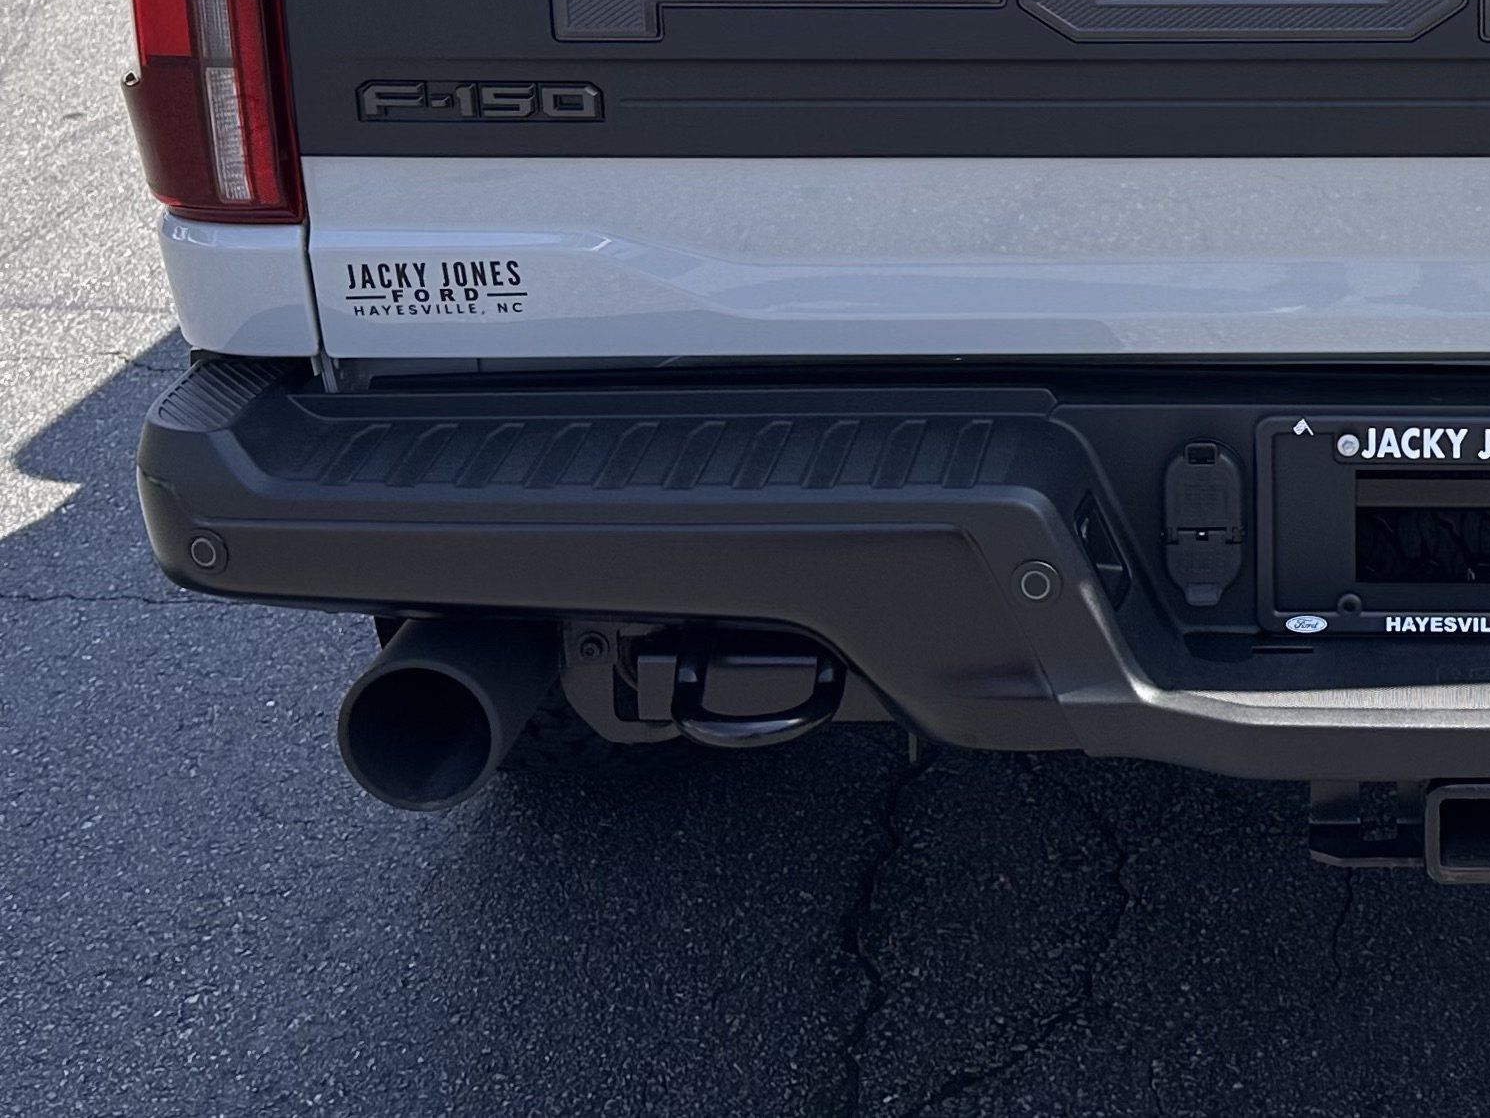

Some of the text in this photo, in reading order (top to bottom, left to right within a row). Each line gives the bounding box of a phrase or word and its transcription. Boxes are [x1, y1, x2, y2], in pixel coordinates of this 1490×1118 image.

[356, 80, 604, 122] F-150
[347, 260, 521, 290] JACKY JONES
[353, 301, 523, 317] HAYESVILLE, NC
[391, 287, 479, 303] FORD
[1361, 427, 1468, 459] JACKY
